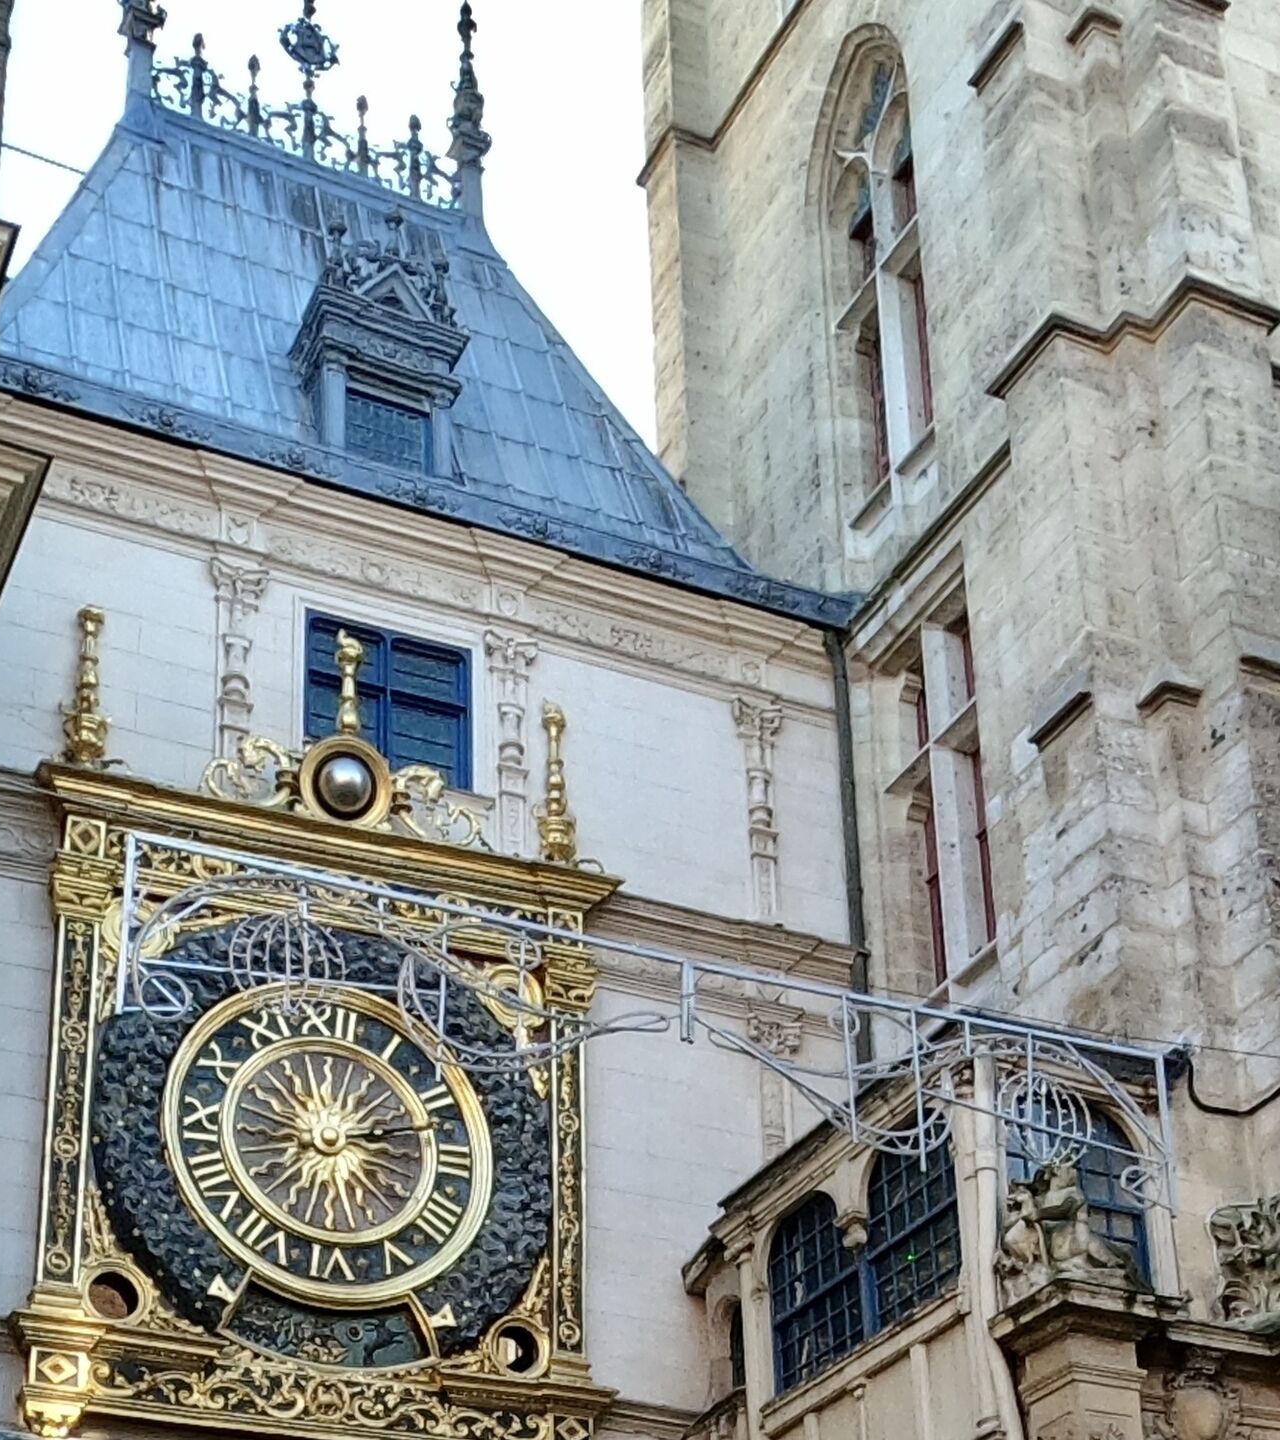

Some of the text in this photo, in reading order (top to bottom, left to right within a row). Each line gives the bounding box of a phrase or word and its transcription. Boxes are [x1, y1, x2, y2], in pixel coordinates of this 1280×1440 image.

[299, 1001, 358, 1044] XII
[195, 1040, 243, 1085] X
[182, 1094, 221, 1143] IX
[382, 1239, 416, 1276] V
